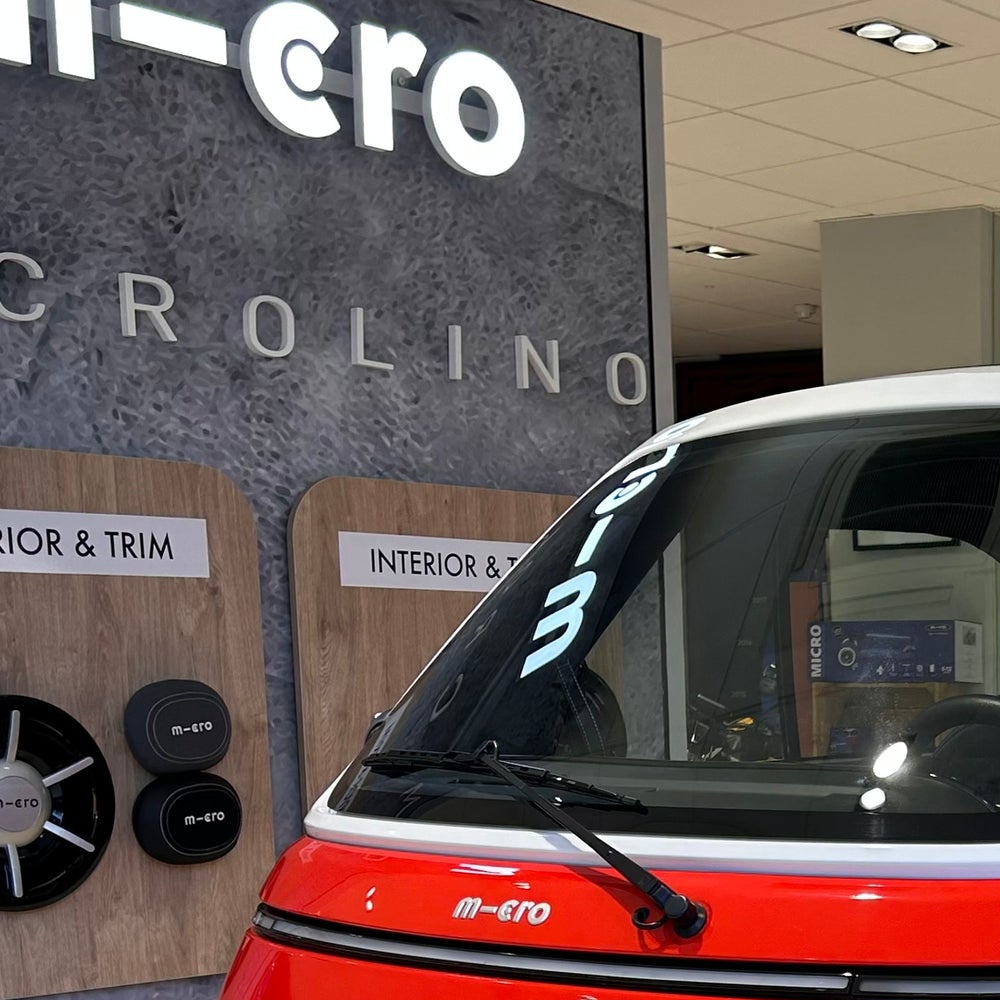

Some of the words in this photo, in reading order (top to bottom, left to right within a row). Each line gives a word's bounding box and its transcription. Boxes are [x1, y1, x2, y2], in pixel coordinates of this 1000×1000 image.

[75, 529, 97, 558] &
[104, 531, 174, 560] TRIM
[370, 548, 478, 578] INTERIOR
[486, 555, 501, 579] &
[809, 624, 822, 678] MICRO
[171, 721, 213, 736] m-cro
[184, 811, 225, 826] m-cro
[452, 897, 552, 926] m-cro
